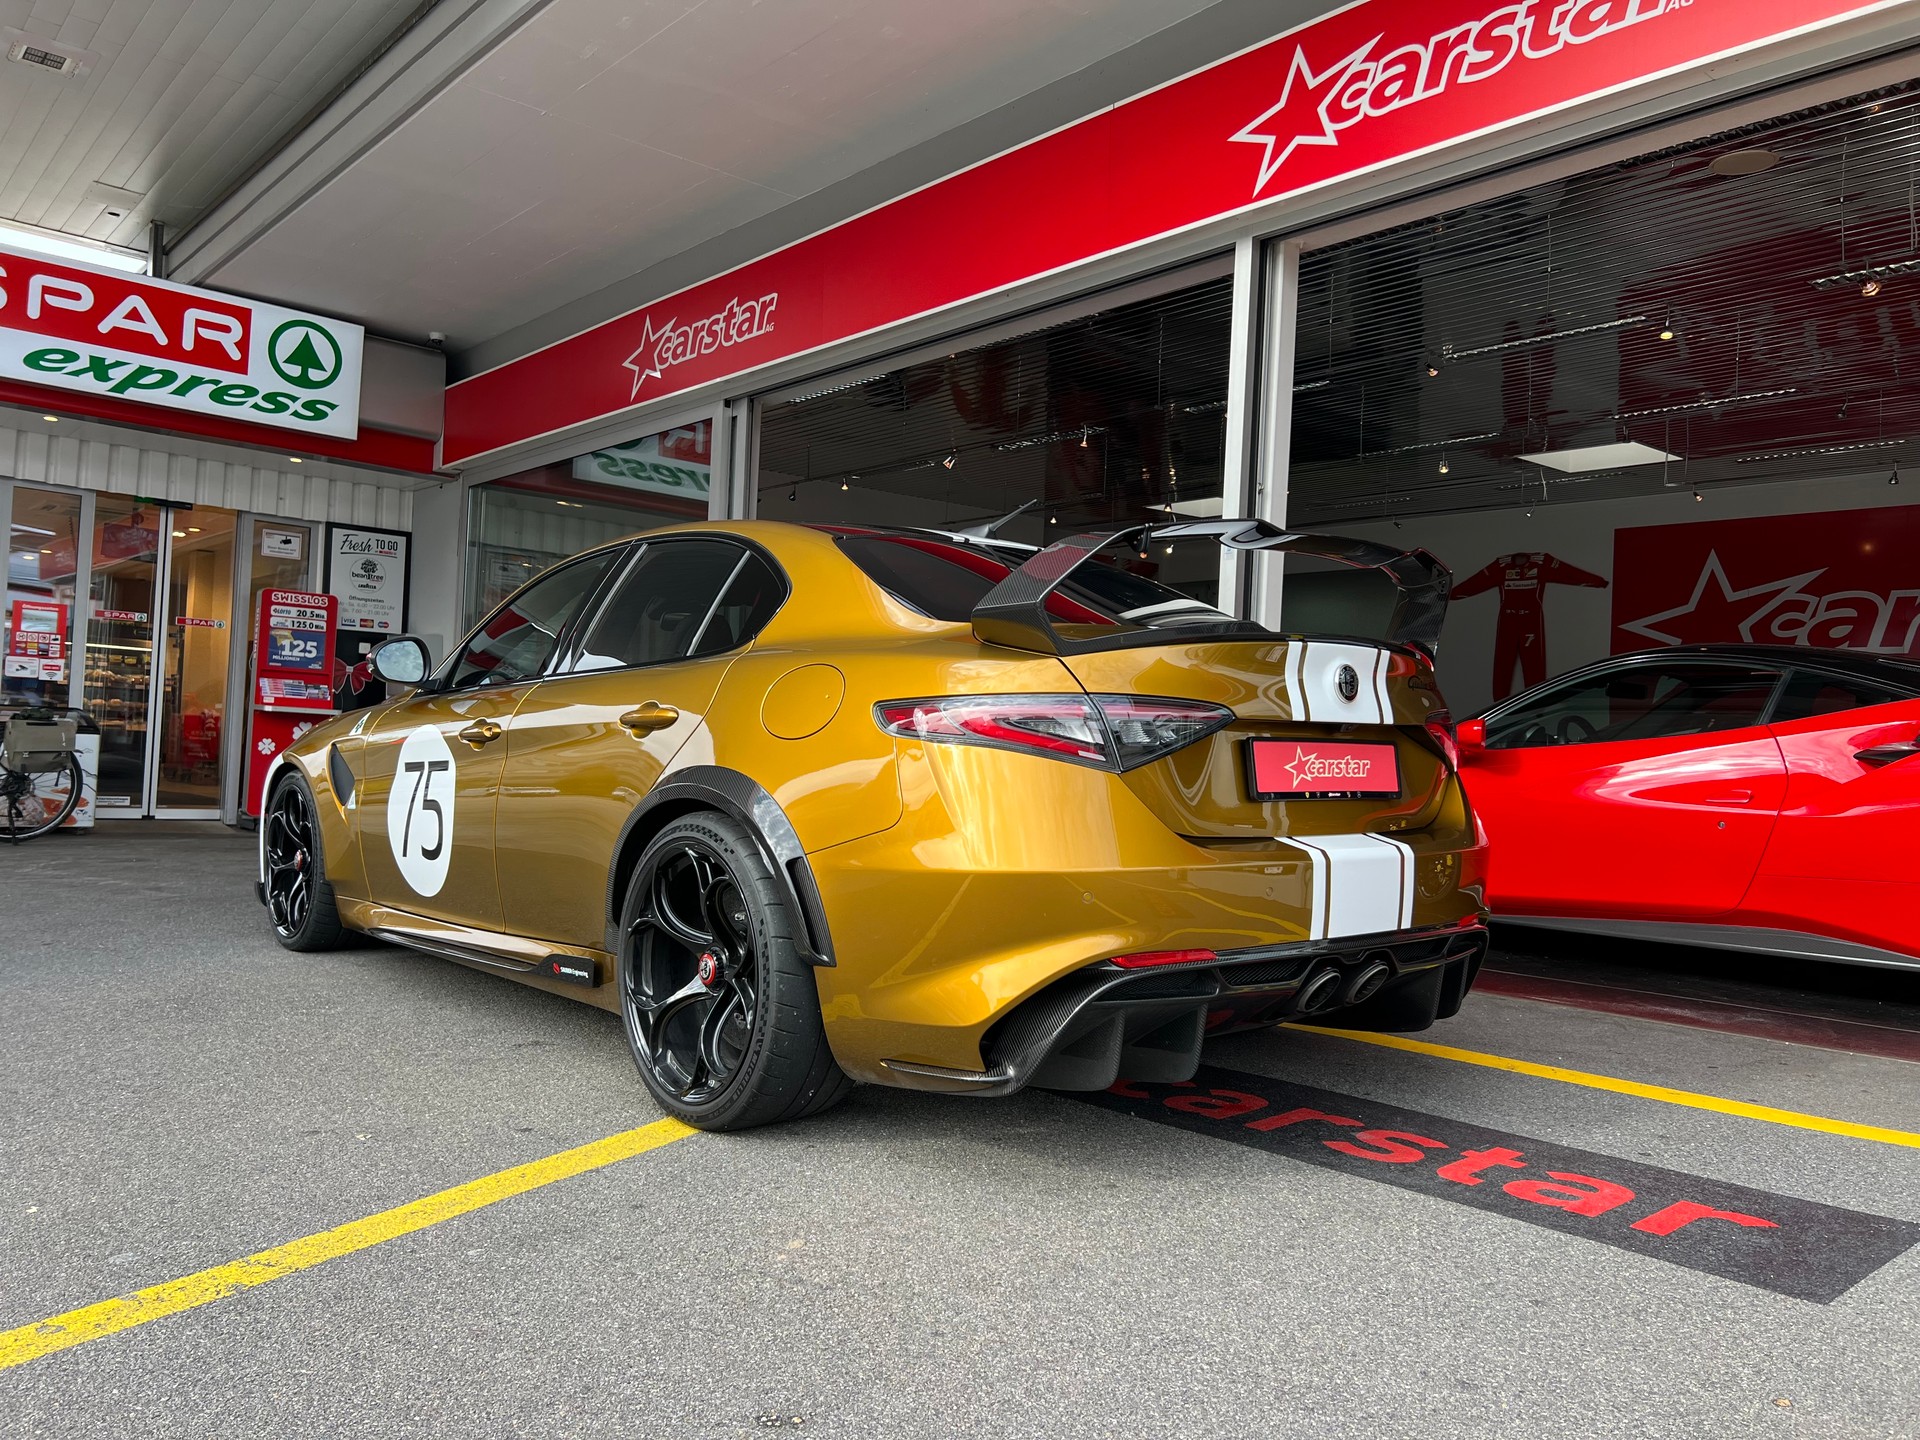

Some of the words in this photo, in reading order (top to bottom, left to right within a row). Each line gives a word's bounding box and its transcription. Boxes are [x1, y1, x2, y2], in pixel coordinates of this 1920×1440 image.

[0, 265, 243, 361] PAR
[654, 293, 778, 370] carstar
[765, 323, 775, 333] AG
[23, 347, 340, 422] express
[340, 533, 373, 552] Fresh
[375, 539, 386, 550] TO
[387, 540, 398, 551] GO
[272, 592, 328, 606] SWISSLOS
[104, 611, 135, 619] SPAR
[186, 619, 215, 627] SPAR
[281, 639, 318, 658] 125
[1525, 634, 1535, 647] 7
[1305, 755, 1370, 778] carstar
[402, 760, 450, 861] 75
